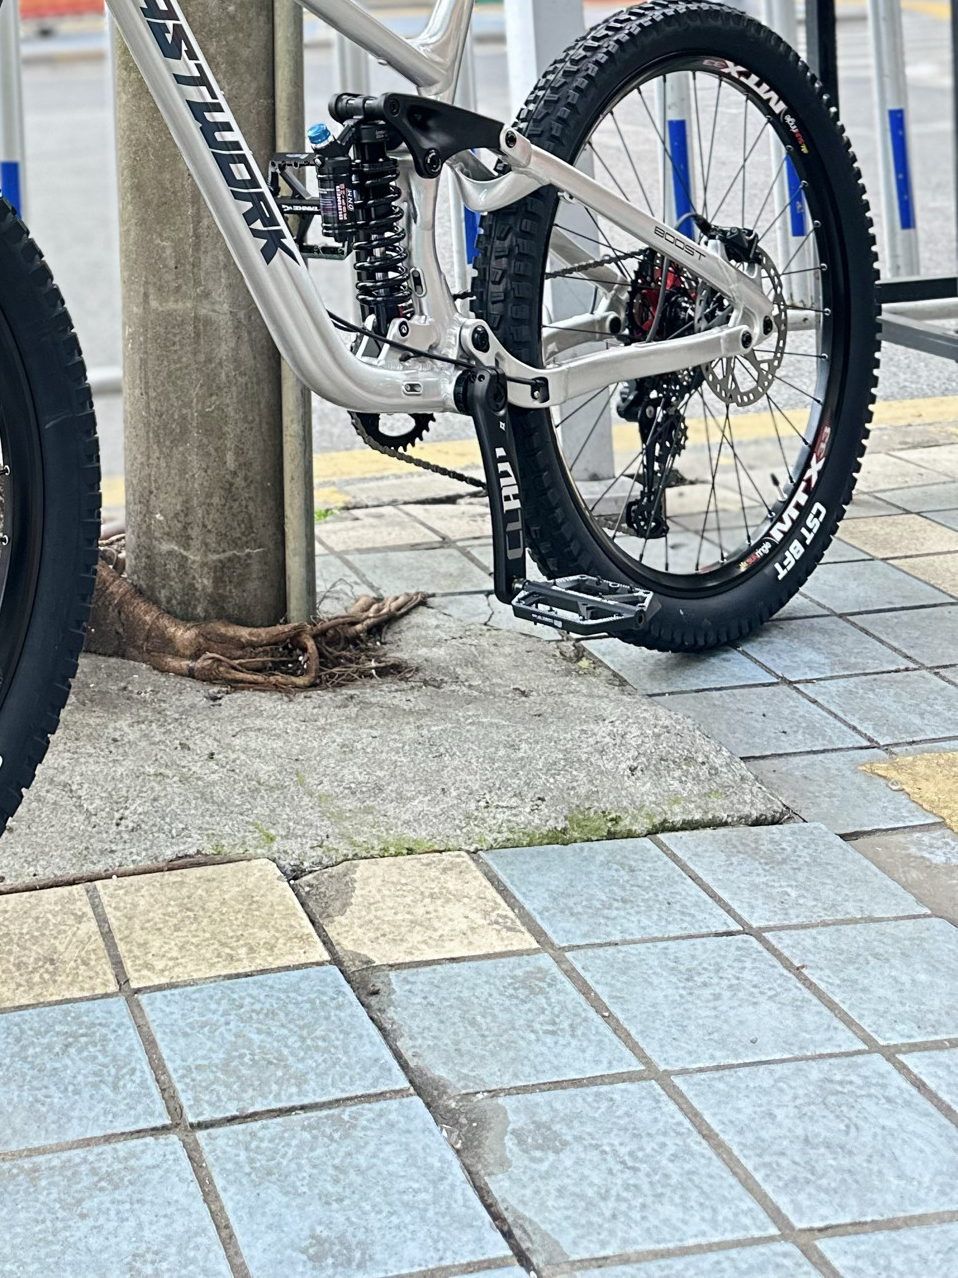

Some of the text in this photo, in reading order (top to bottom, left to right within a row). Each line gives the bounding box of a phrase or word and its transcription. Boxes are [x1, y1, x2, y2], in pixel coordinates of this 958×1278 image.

[653, 225, 706, 261] BOOST
[773, 501, 827, 581] CST BFT
